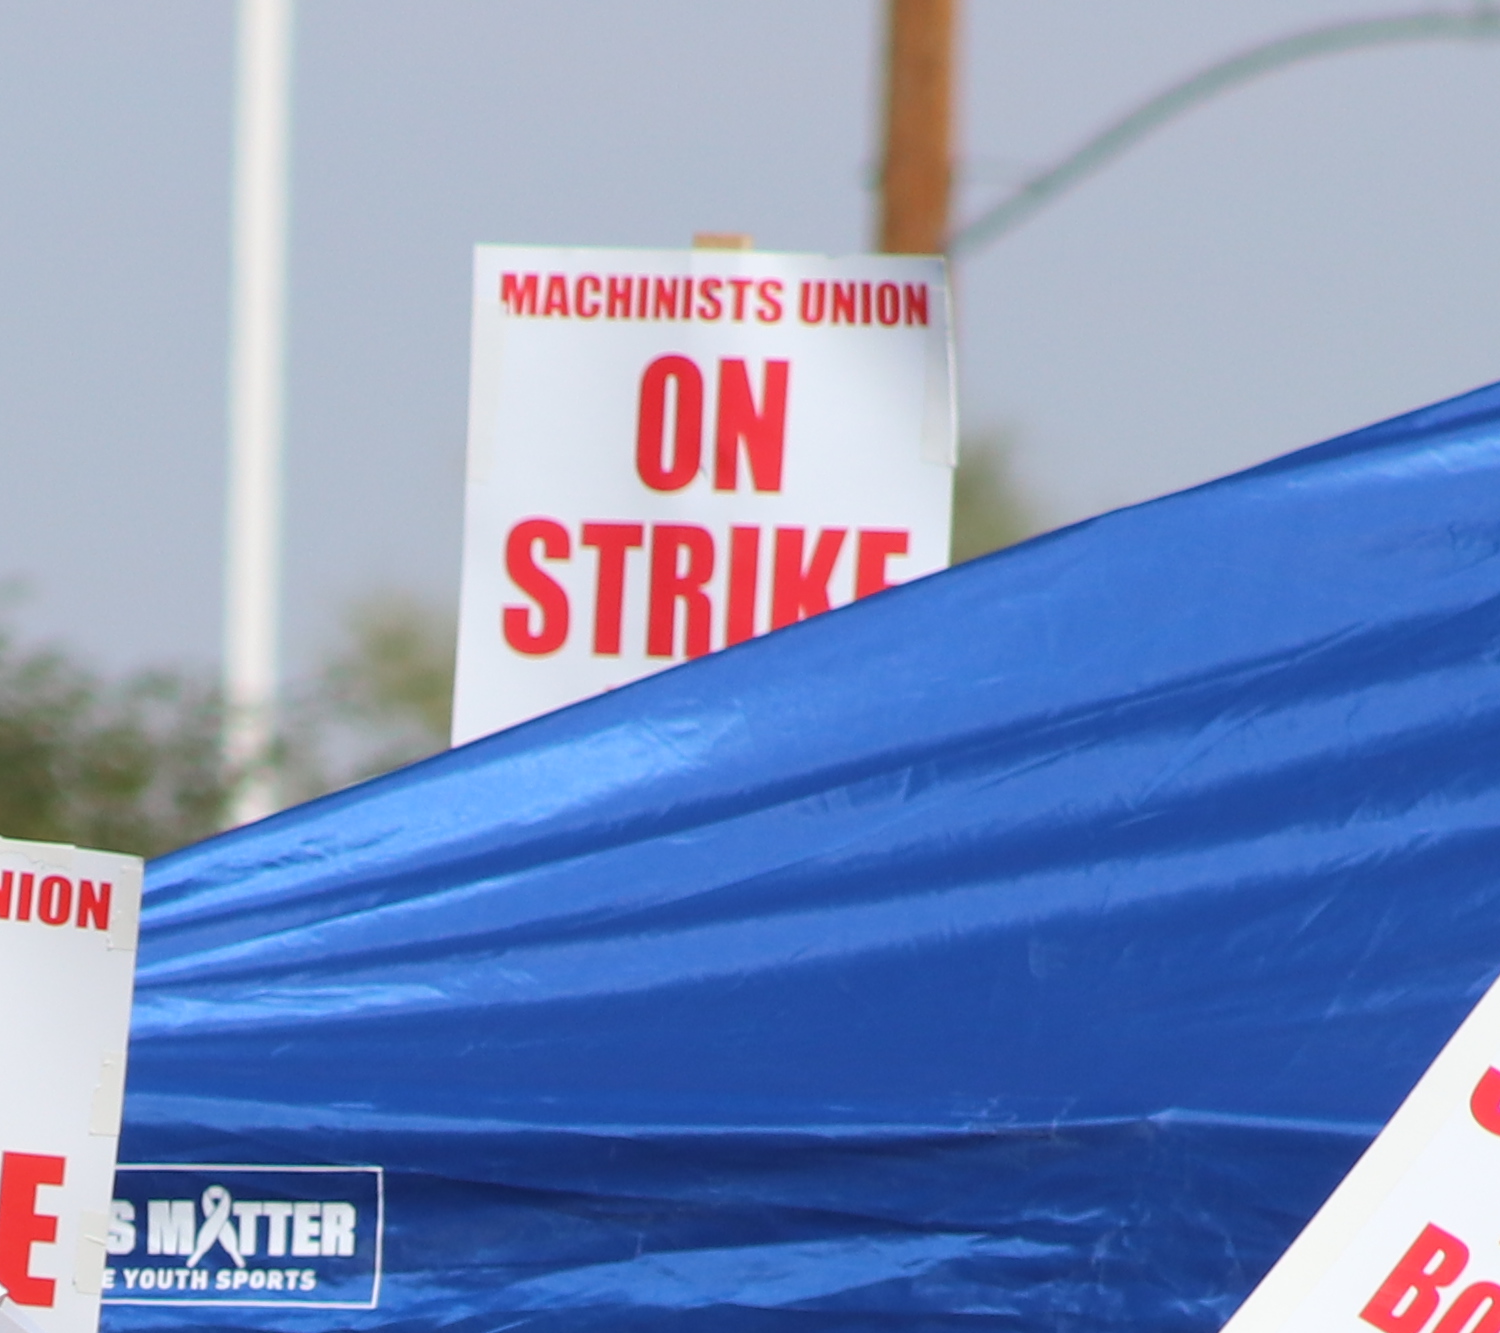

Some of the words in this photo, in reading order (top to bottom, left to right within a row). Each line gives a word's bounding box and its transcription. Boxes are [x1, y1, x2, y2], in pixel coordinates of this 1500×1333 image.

[501, 274, 783, 323] MACHINISTS
[799, 282, 928, 326] UNION
[636, 355, 790, 492] ON
[123, 1268, 209, 1290] YOUTH
[215, 1269, 317, 1291] SPORTS
